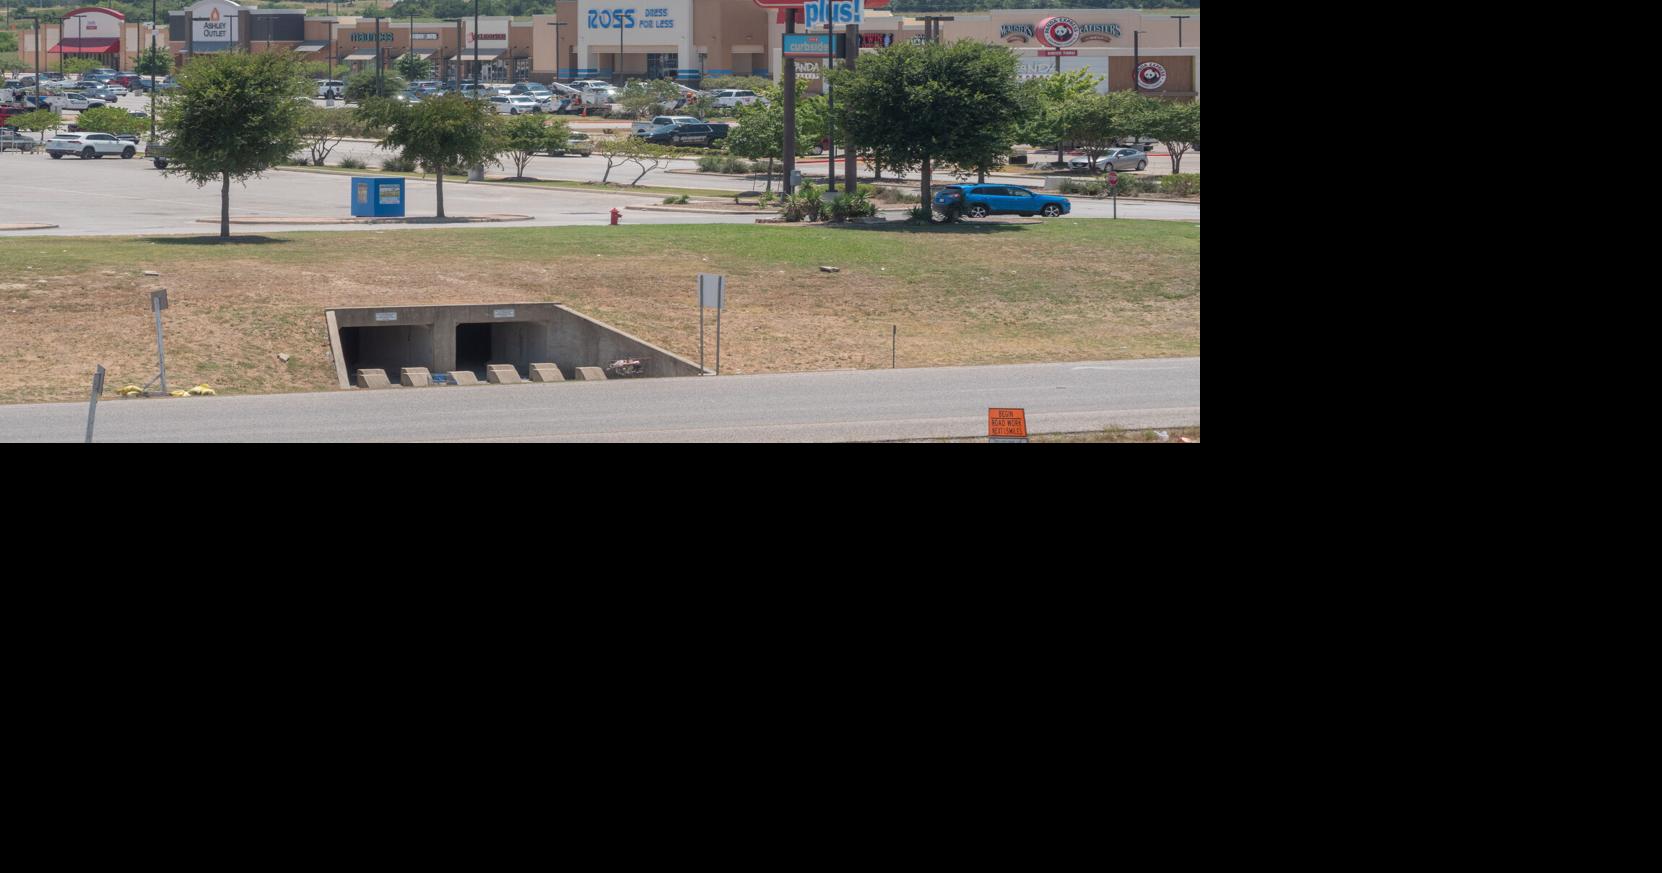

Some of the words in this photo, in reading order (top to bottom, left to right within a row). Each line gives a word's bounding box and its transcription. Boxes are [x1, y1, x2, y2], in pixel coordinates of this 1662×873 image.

[645, 8, 668, 17] DRESS
[806, 0, 862, 29] plus!
[588, 9, 635, 29] ROSS
[639, 20, 653, 28] FOR
[656, 20, 674, 28] LESS
[351, 32, 394, 42] maurces
[795, 62, 819, 72] ANDA
[1007, 419, 1022, 427] WORK
